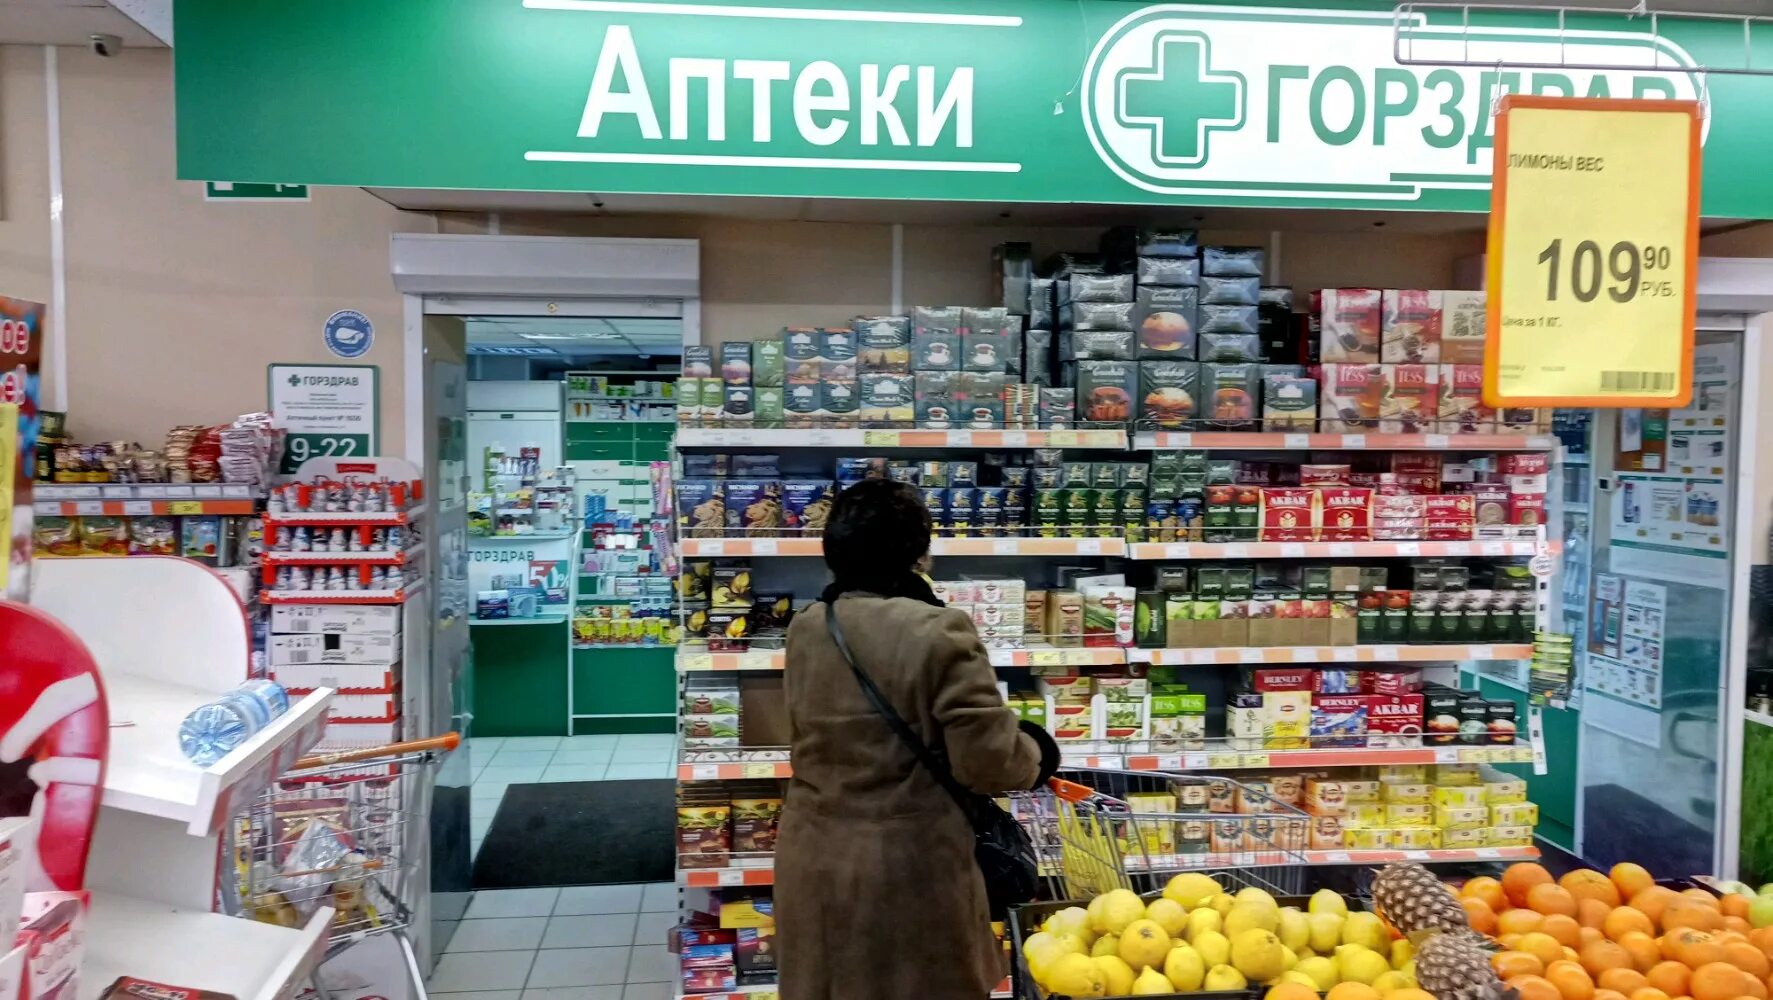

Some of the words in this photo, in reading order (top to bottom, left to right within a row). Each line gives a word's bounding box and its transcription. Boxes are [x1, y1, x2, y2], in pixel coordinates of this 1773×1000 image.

[577, 24, 974, 148] Аптеки
[1576, 157, 1604, 171] ВЕС
[1537, 238, 1641, 303] 109
[1642, 246, 1671, 271] 90
[1640, 281, 1677, 297] РУБ.
[290, 437, 357, 462] 9-22
[1373, 704, 1418, 715] AKBAR
